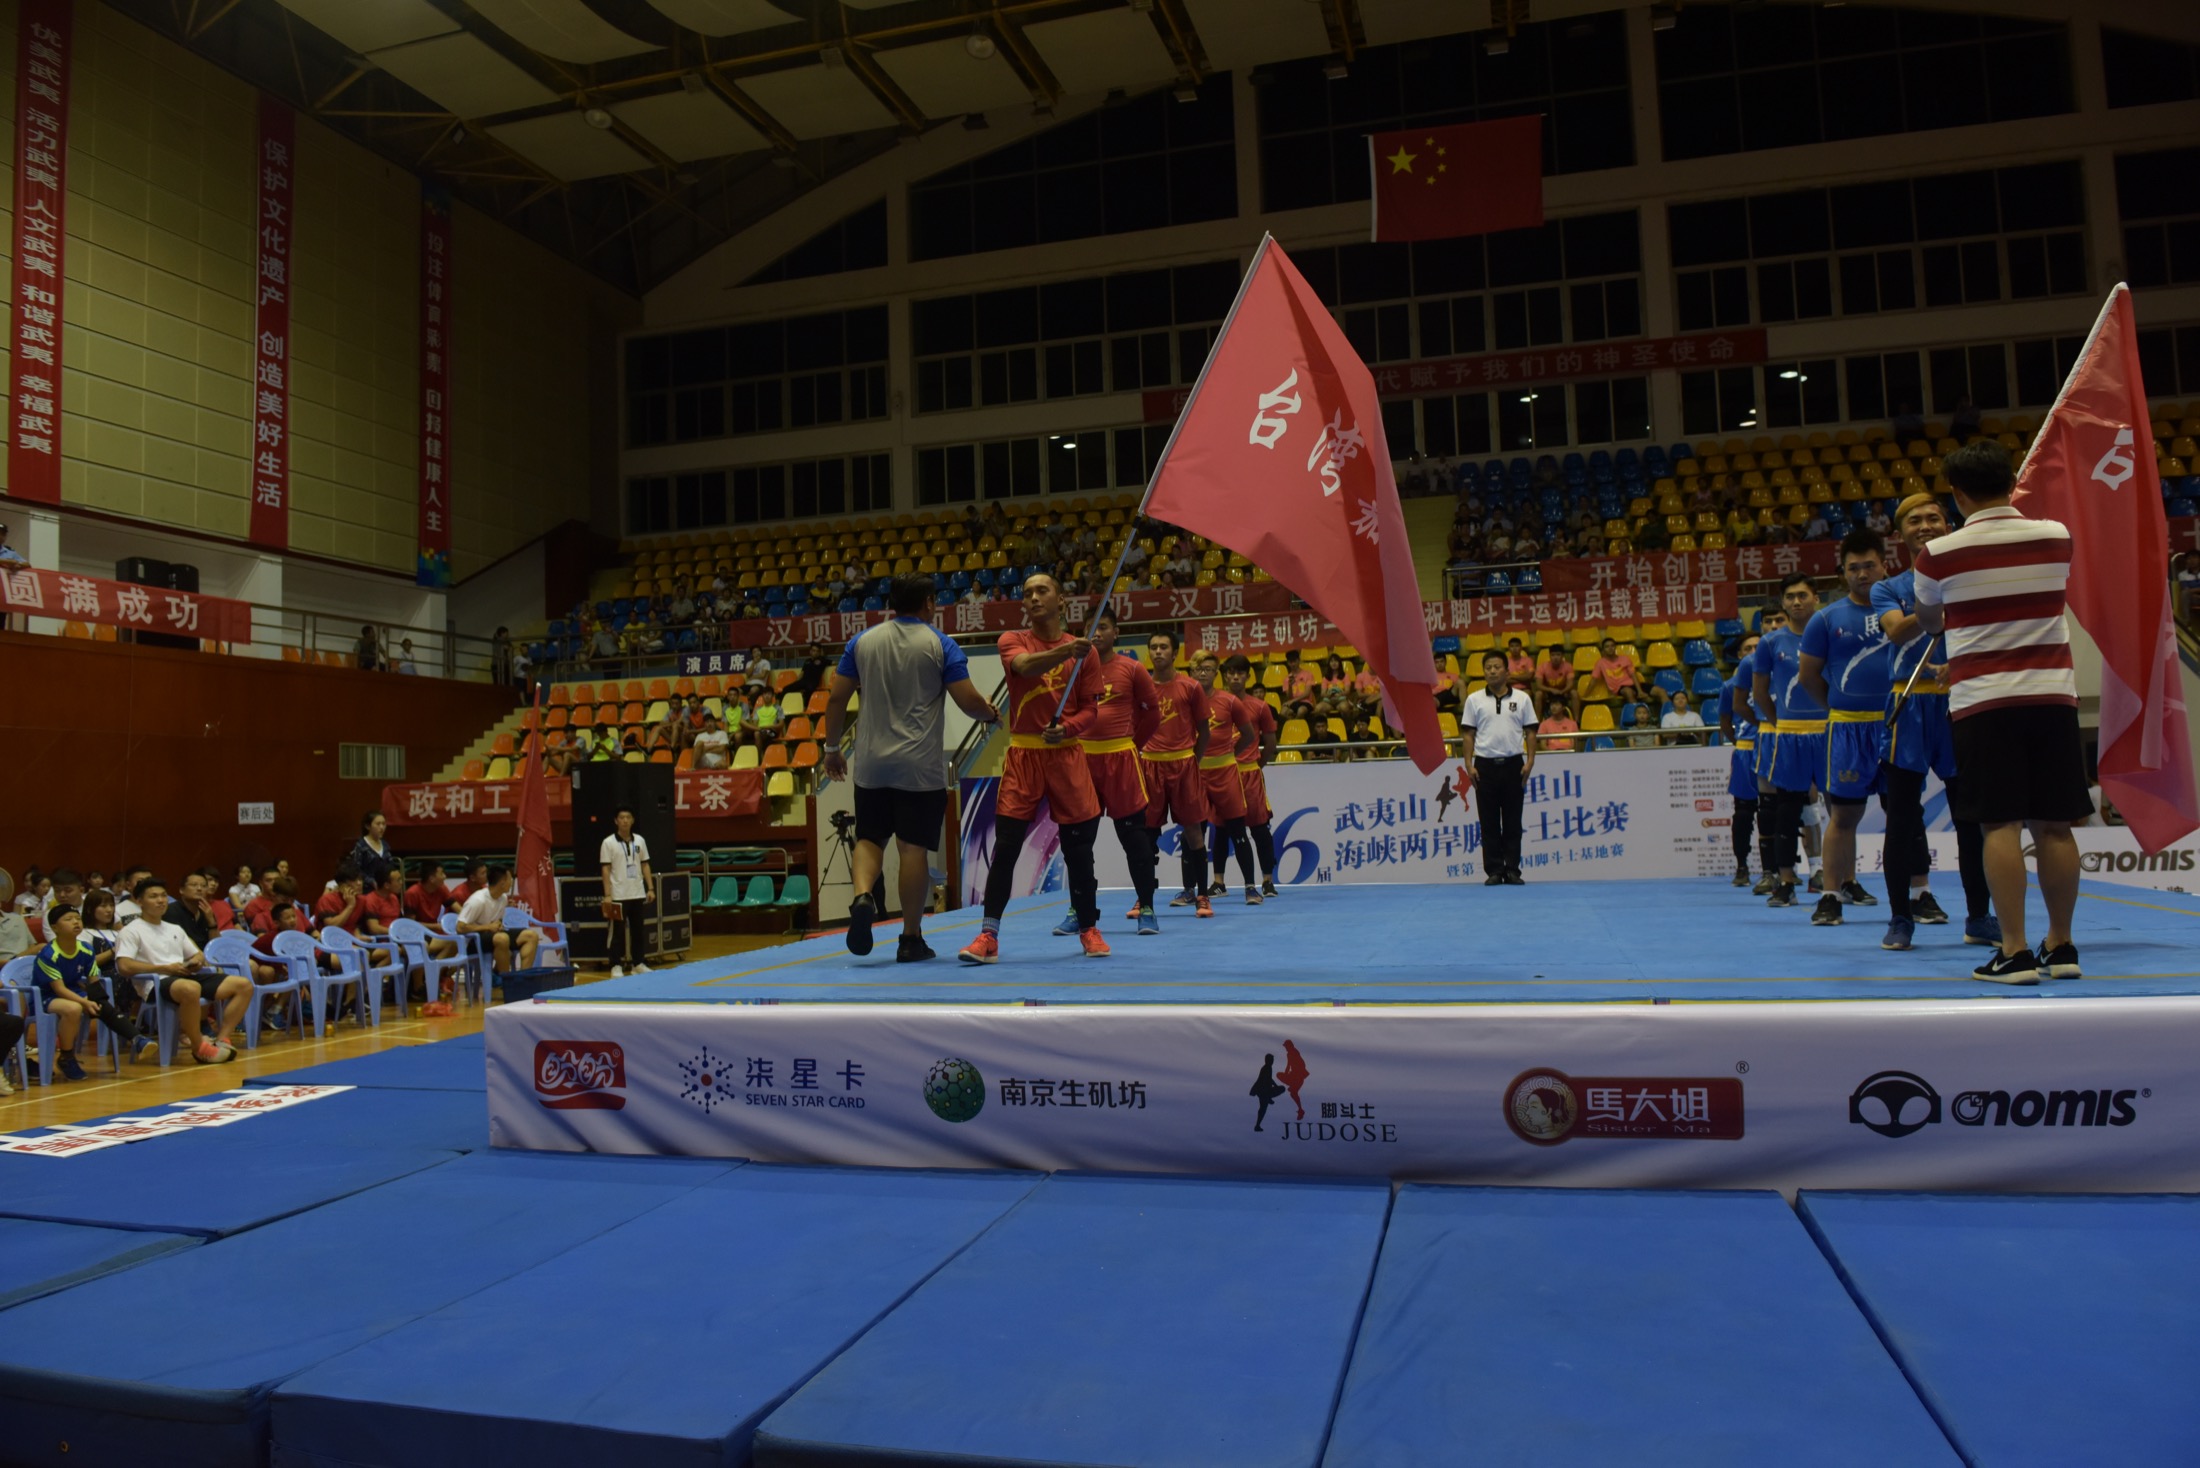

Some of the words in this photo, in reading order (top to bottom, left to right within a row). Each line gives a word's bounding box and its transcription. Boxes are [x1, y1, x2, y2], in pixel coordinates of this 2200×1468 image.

[29, 22, 62, 105] 优美武夷
[25, 108, 59, 191] 活力武夷
[22, 200, 57, 279] 人文武夷
[259, 137, 289, 307] 保护文化遗产
[19, 283, 56, 367] 和谐武夷
[18, 374, 54, 455] 幸福武夷
[256, 331, 285, 509] 创造美好生活
[425, 388, 443, 532] 回报健康人生
[0, 567, 198, 631] 圆满成功
[1425, 583, 1715, 632] 祝脚斗士运动员载誉而归
[686, 653, 746, 675] 演员席
[1334, 794, 1426, 834] 武夷山
[745, 1093, 787, 1107] SEVEN
[792, 1094, 825, 1108] STAR
[828, 1096, 866, 1109] CARD
[999, 1077, 1147, 1110] 南京生矶坊
[1321, 1102, 1375, 1119] 脚斗士
[1586, 1087, 1711, 1122] 馬大姐
[1281, 1121, 1398, 1143] JUDOSE
[1587, 1124, 1657, 1133] Sister
[1673, 1125, 1711, 1134] Ma
